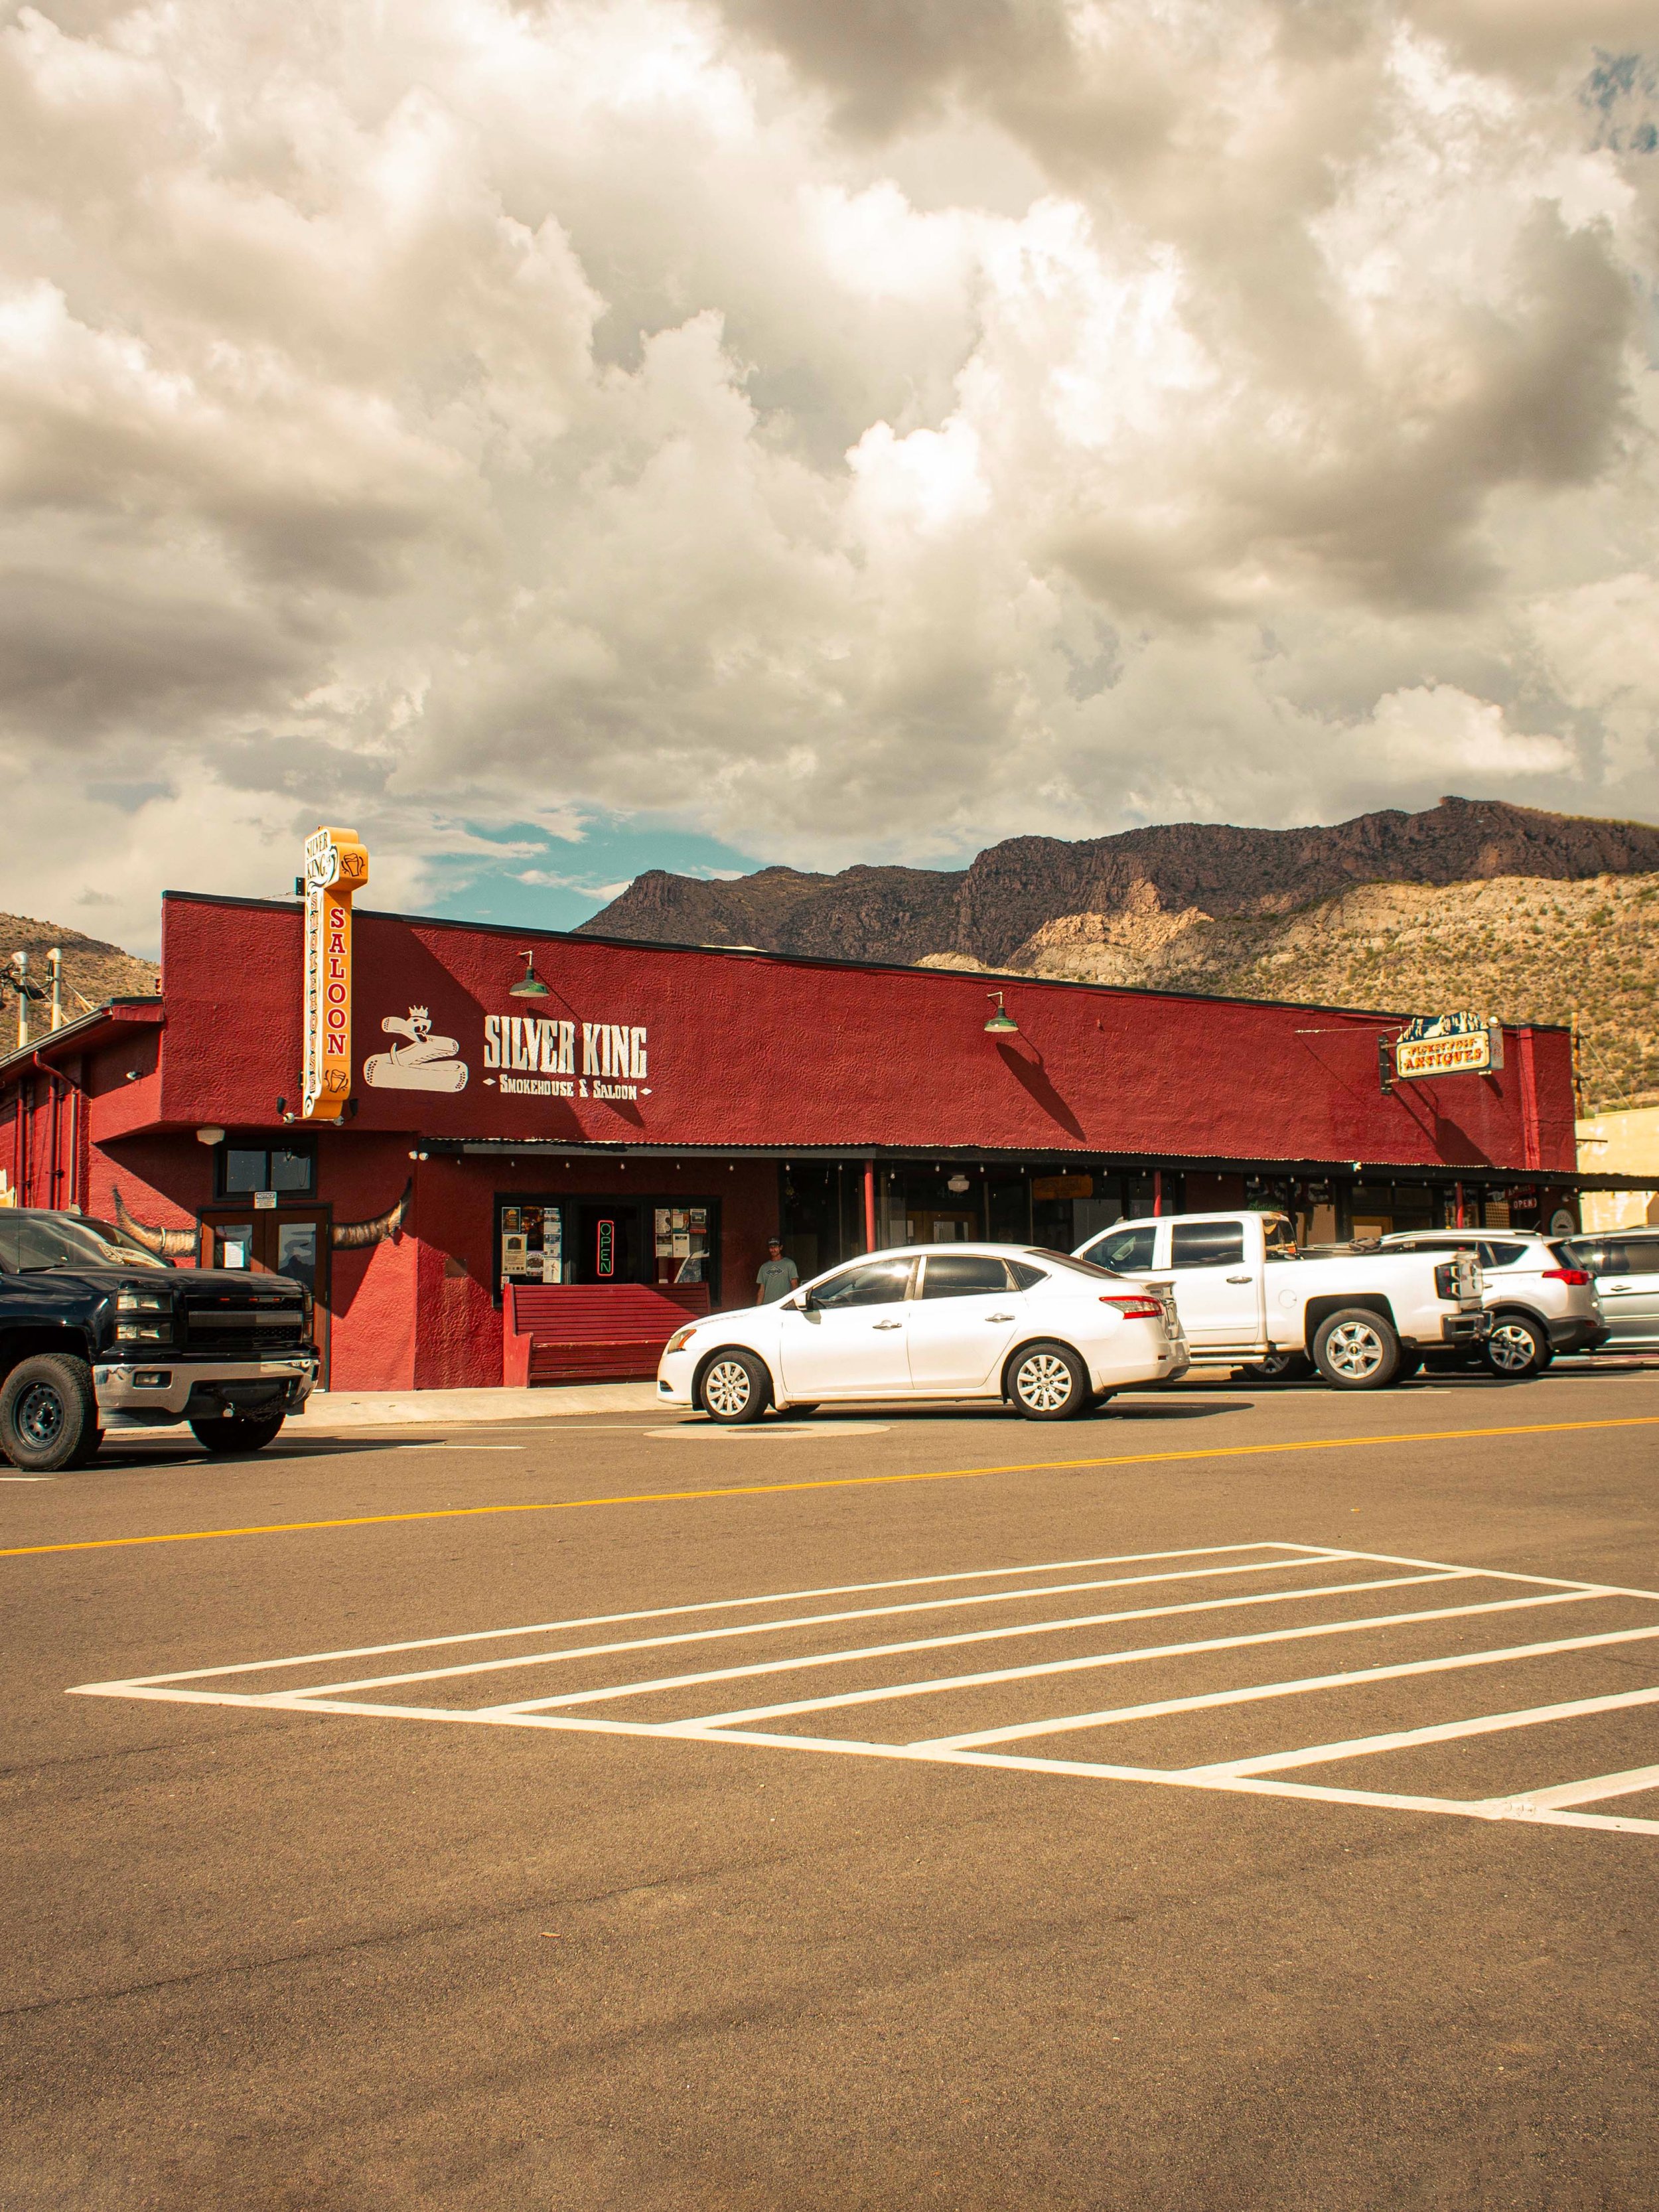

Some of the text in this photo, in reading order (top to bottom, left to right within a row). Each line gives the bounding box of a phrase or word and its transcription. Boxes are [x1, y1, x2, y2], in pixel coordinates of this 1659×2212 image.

[307, 832, 328, 858] SILVER
[307, 853, 326, 880] KING
[309, 891, 319, 1093] SMOKEHOUSE
[327, 908, 347, 1055] SALOON
[484, 1015, 647, 1078] SILVER KING
[1404, 1048, 1482, 1070] ANTIQUES
[579, 1078, 589, 1098] &
[1514, 1199, 1532, 1208] OPEN
[601, 1224, 611, 1272] OPEN
